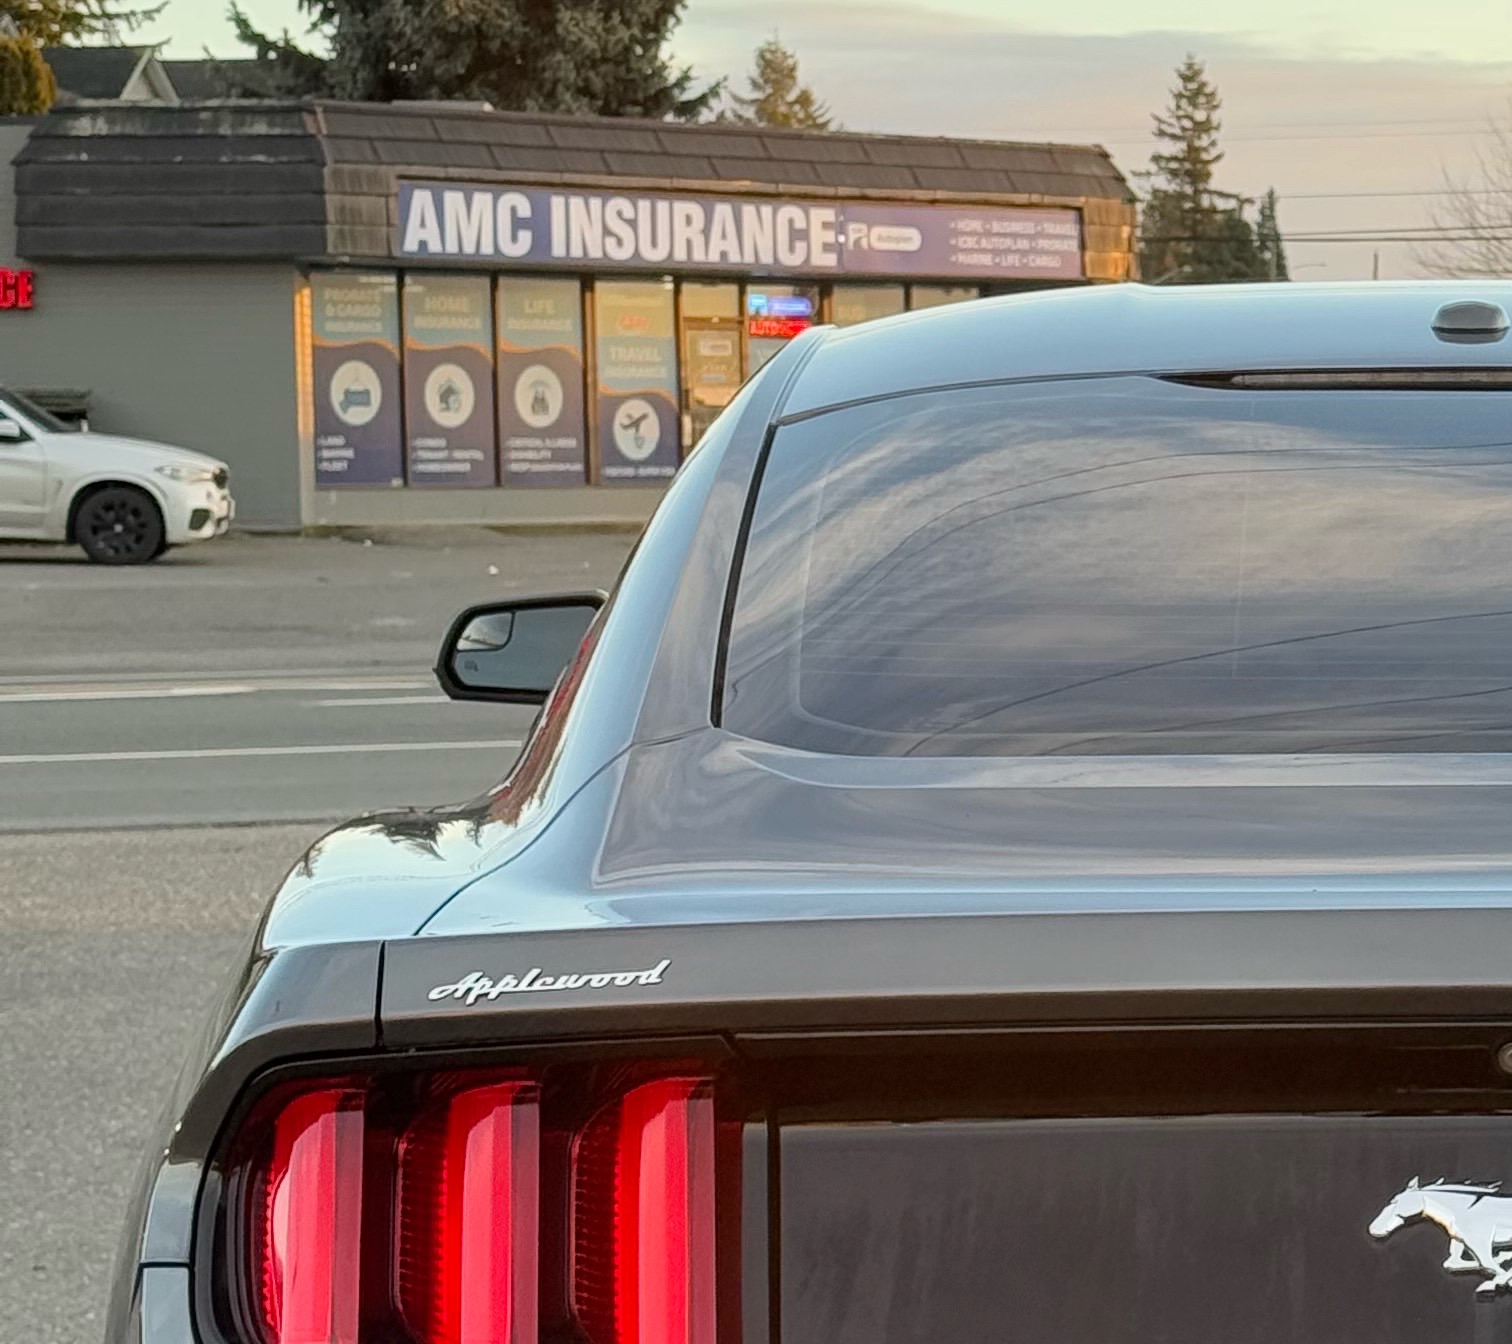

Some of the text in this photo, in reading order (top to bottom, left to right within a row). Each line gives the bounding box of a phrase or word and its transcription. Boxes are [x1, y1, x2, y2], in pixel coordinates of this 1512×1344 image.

[402, 188, 838, 267] AMC INSURANCE
[427, 958, 672, 1006] Applewood
